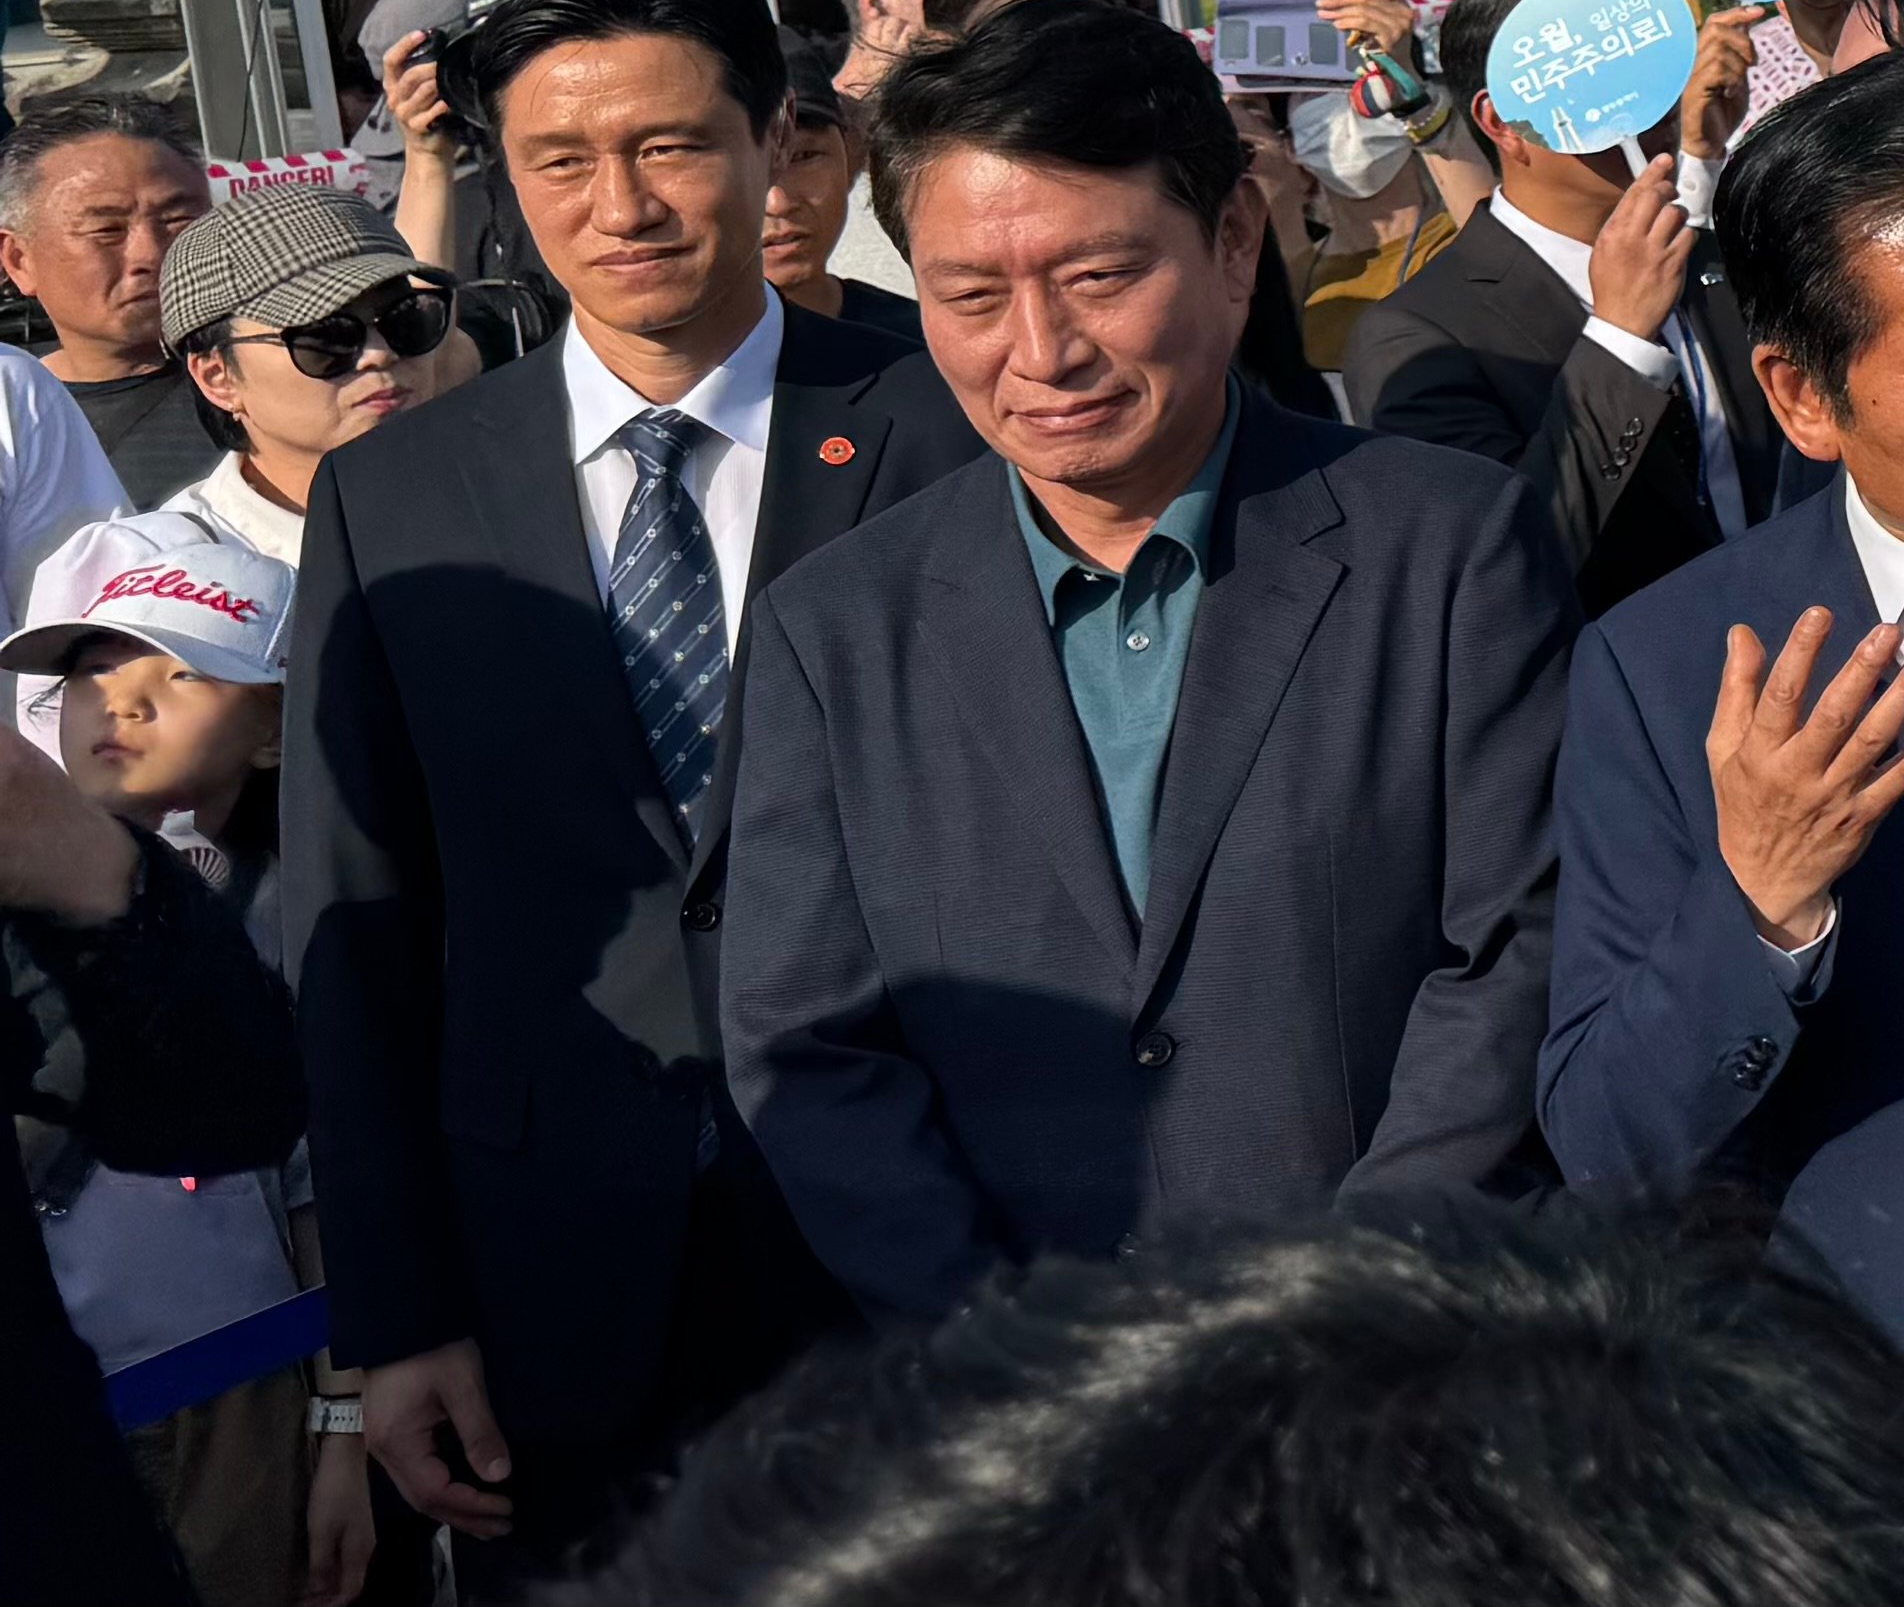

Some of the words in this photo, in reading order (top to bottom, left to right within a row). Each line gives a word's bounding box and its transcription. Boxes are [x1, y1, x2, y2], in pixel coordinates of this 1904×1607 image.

[1509, 9, 1673, 104] 민주주의로!
[1512, 17, 1584, 69] 오월,
[81, 562, 261, 624] Titleist
